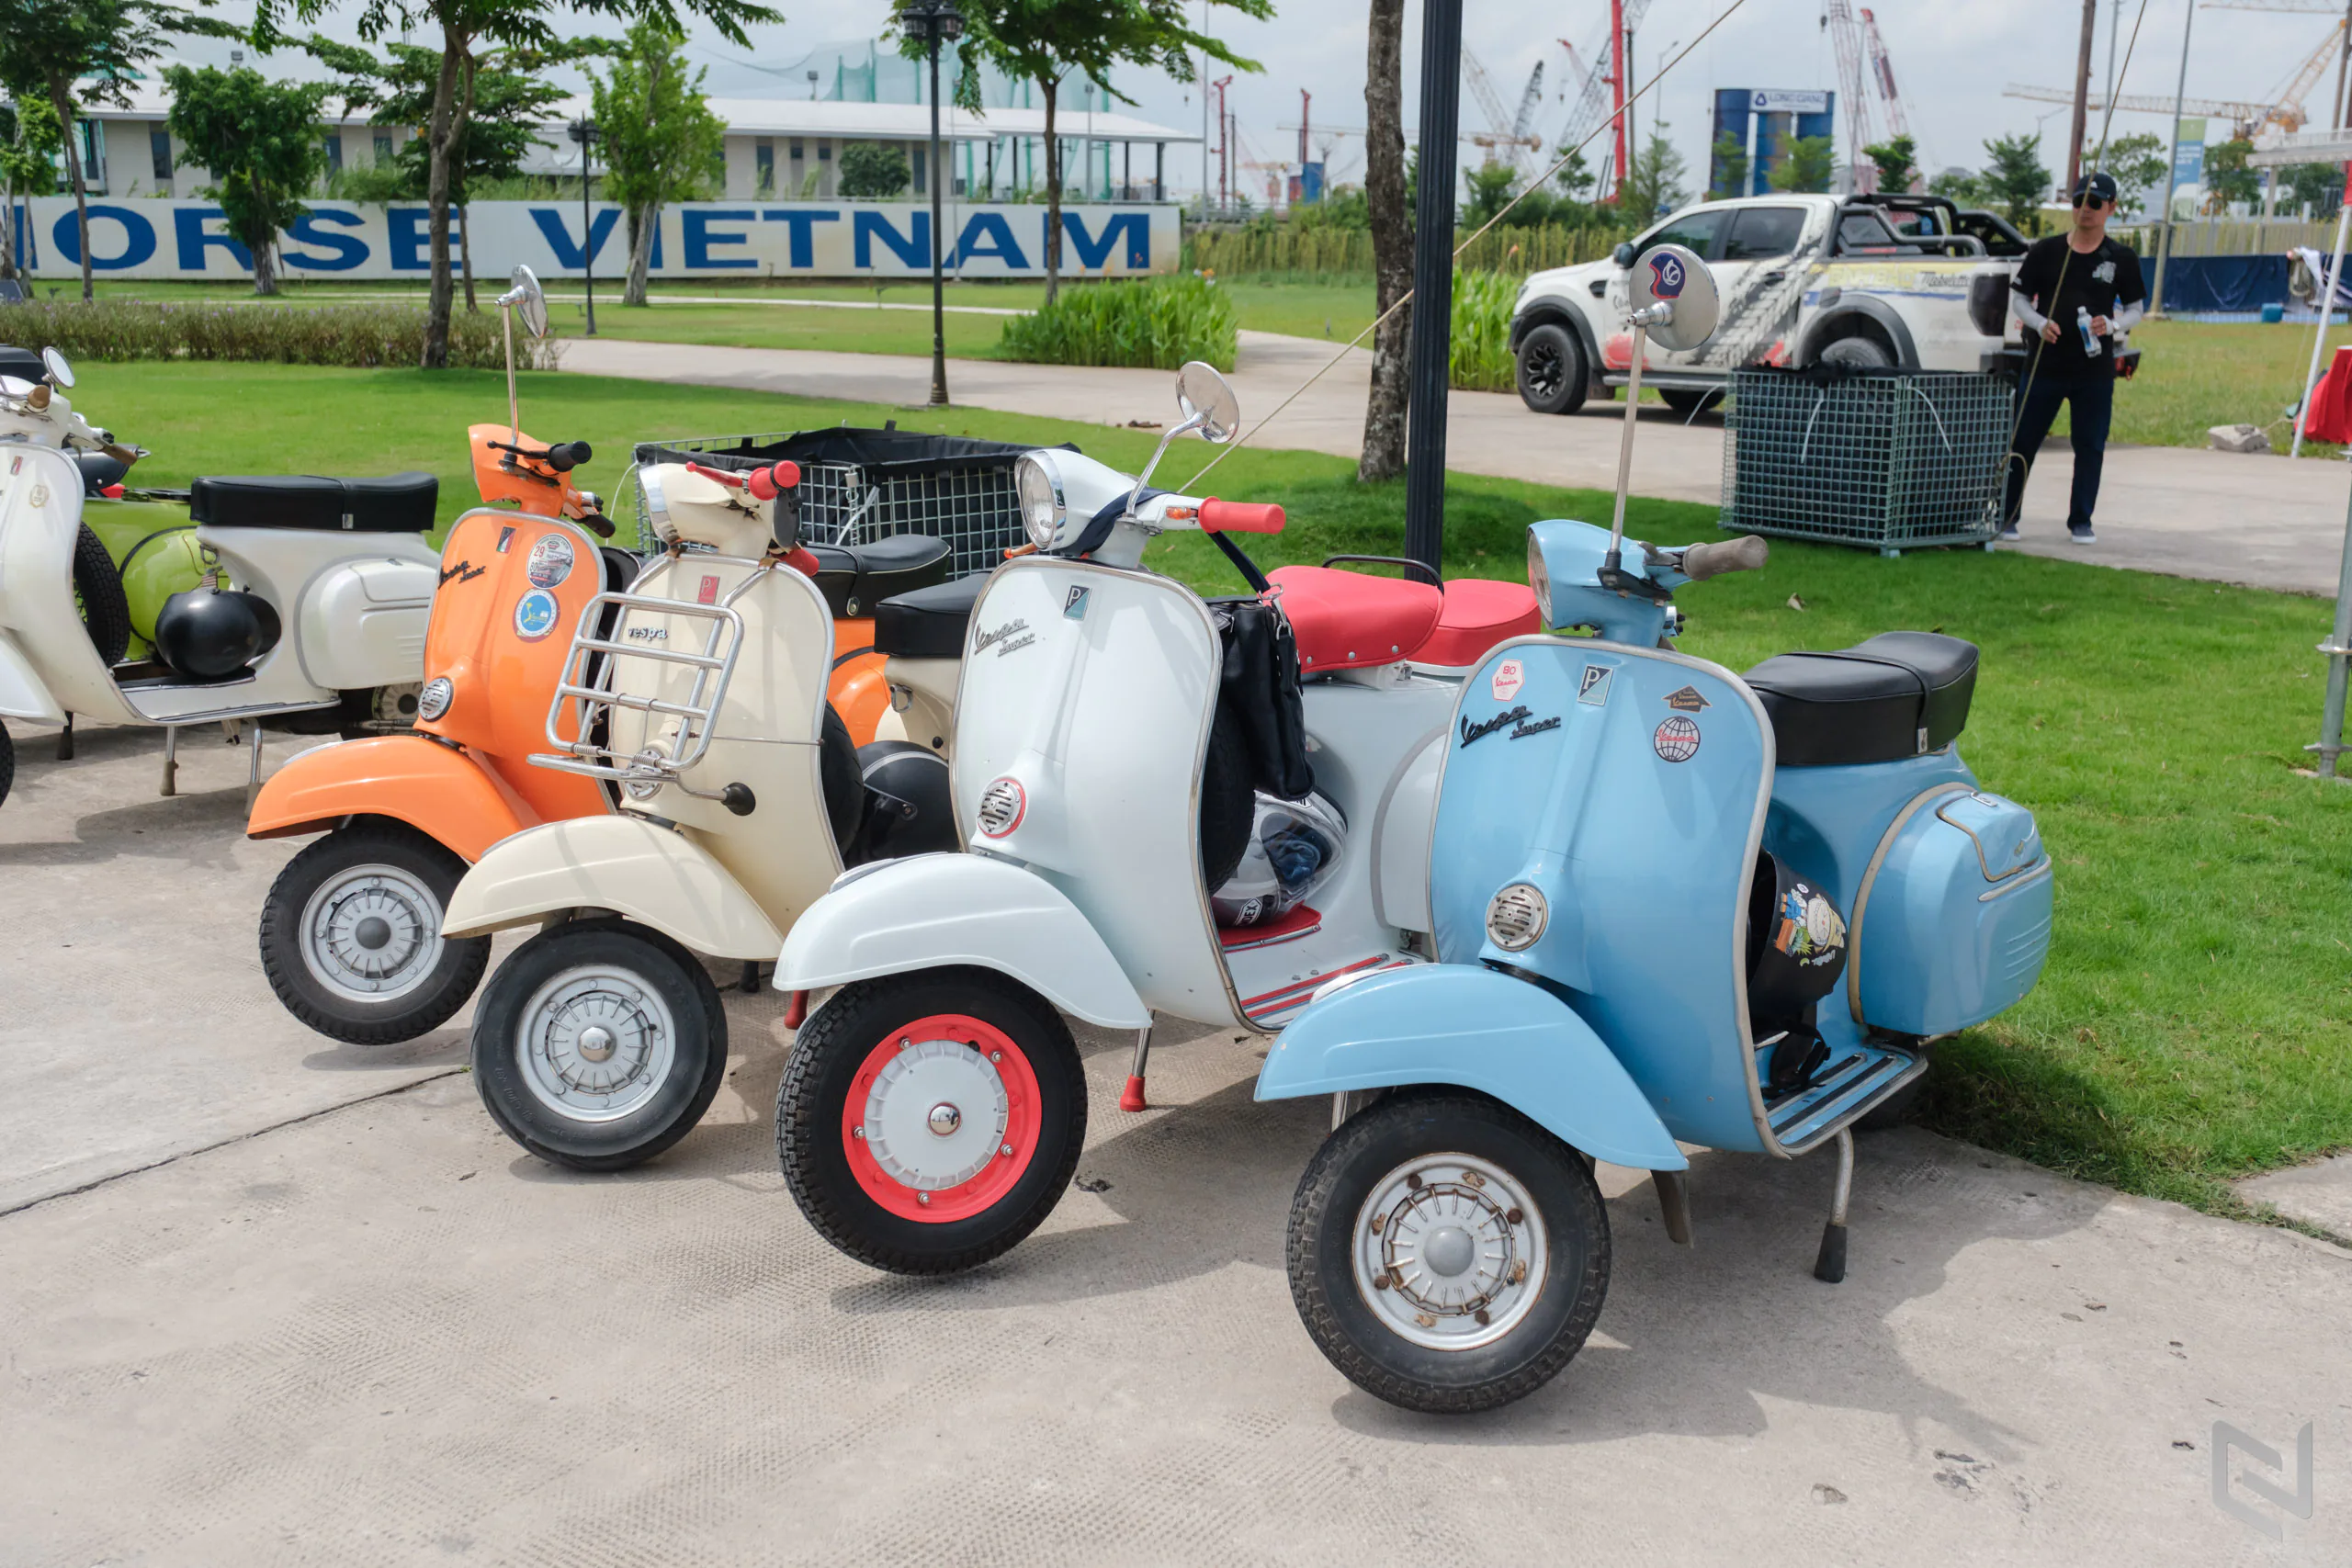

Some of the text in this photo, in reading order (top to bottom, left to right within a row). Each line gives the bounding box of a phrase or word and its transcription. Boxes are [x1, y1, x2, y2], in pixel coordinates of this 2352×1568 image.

[534, 545, 546, 558] 29
[1068, 587, 1081, 606] P
[628, 627, 668, 642] vespa
[974, 617, 1030, 656] Vespa
[1502, 665, 1517, 675] 80
[1583, 668, 1600, 690] P
[1460, 705, 1561, 749] Vespa Super
